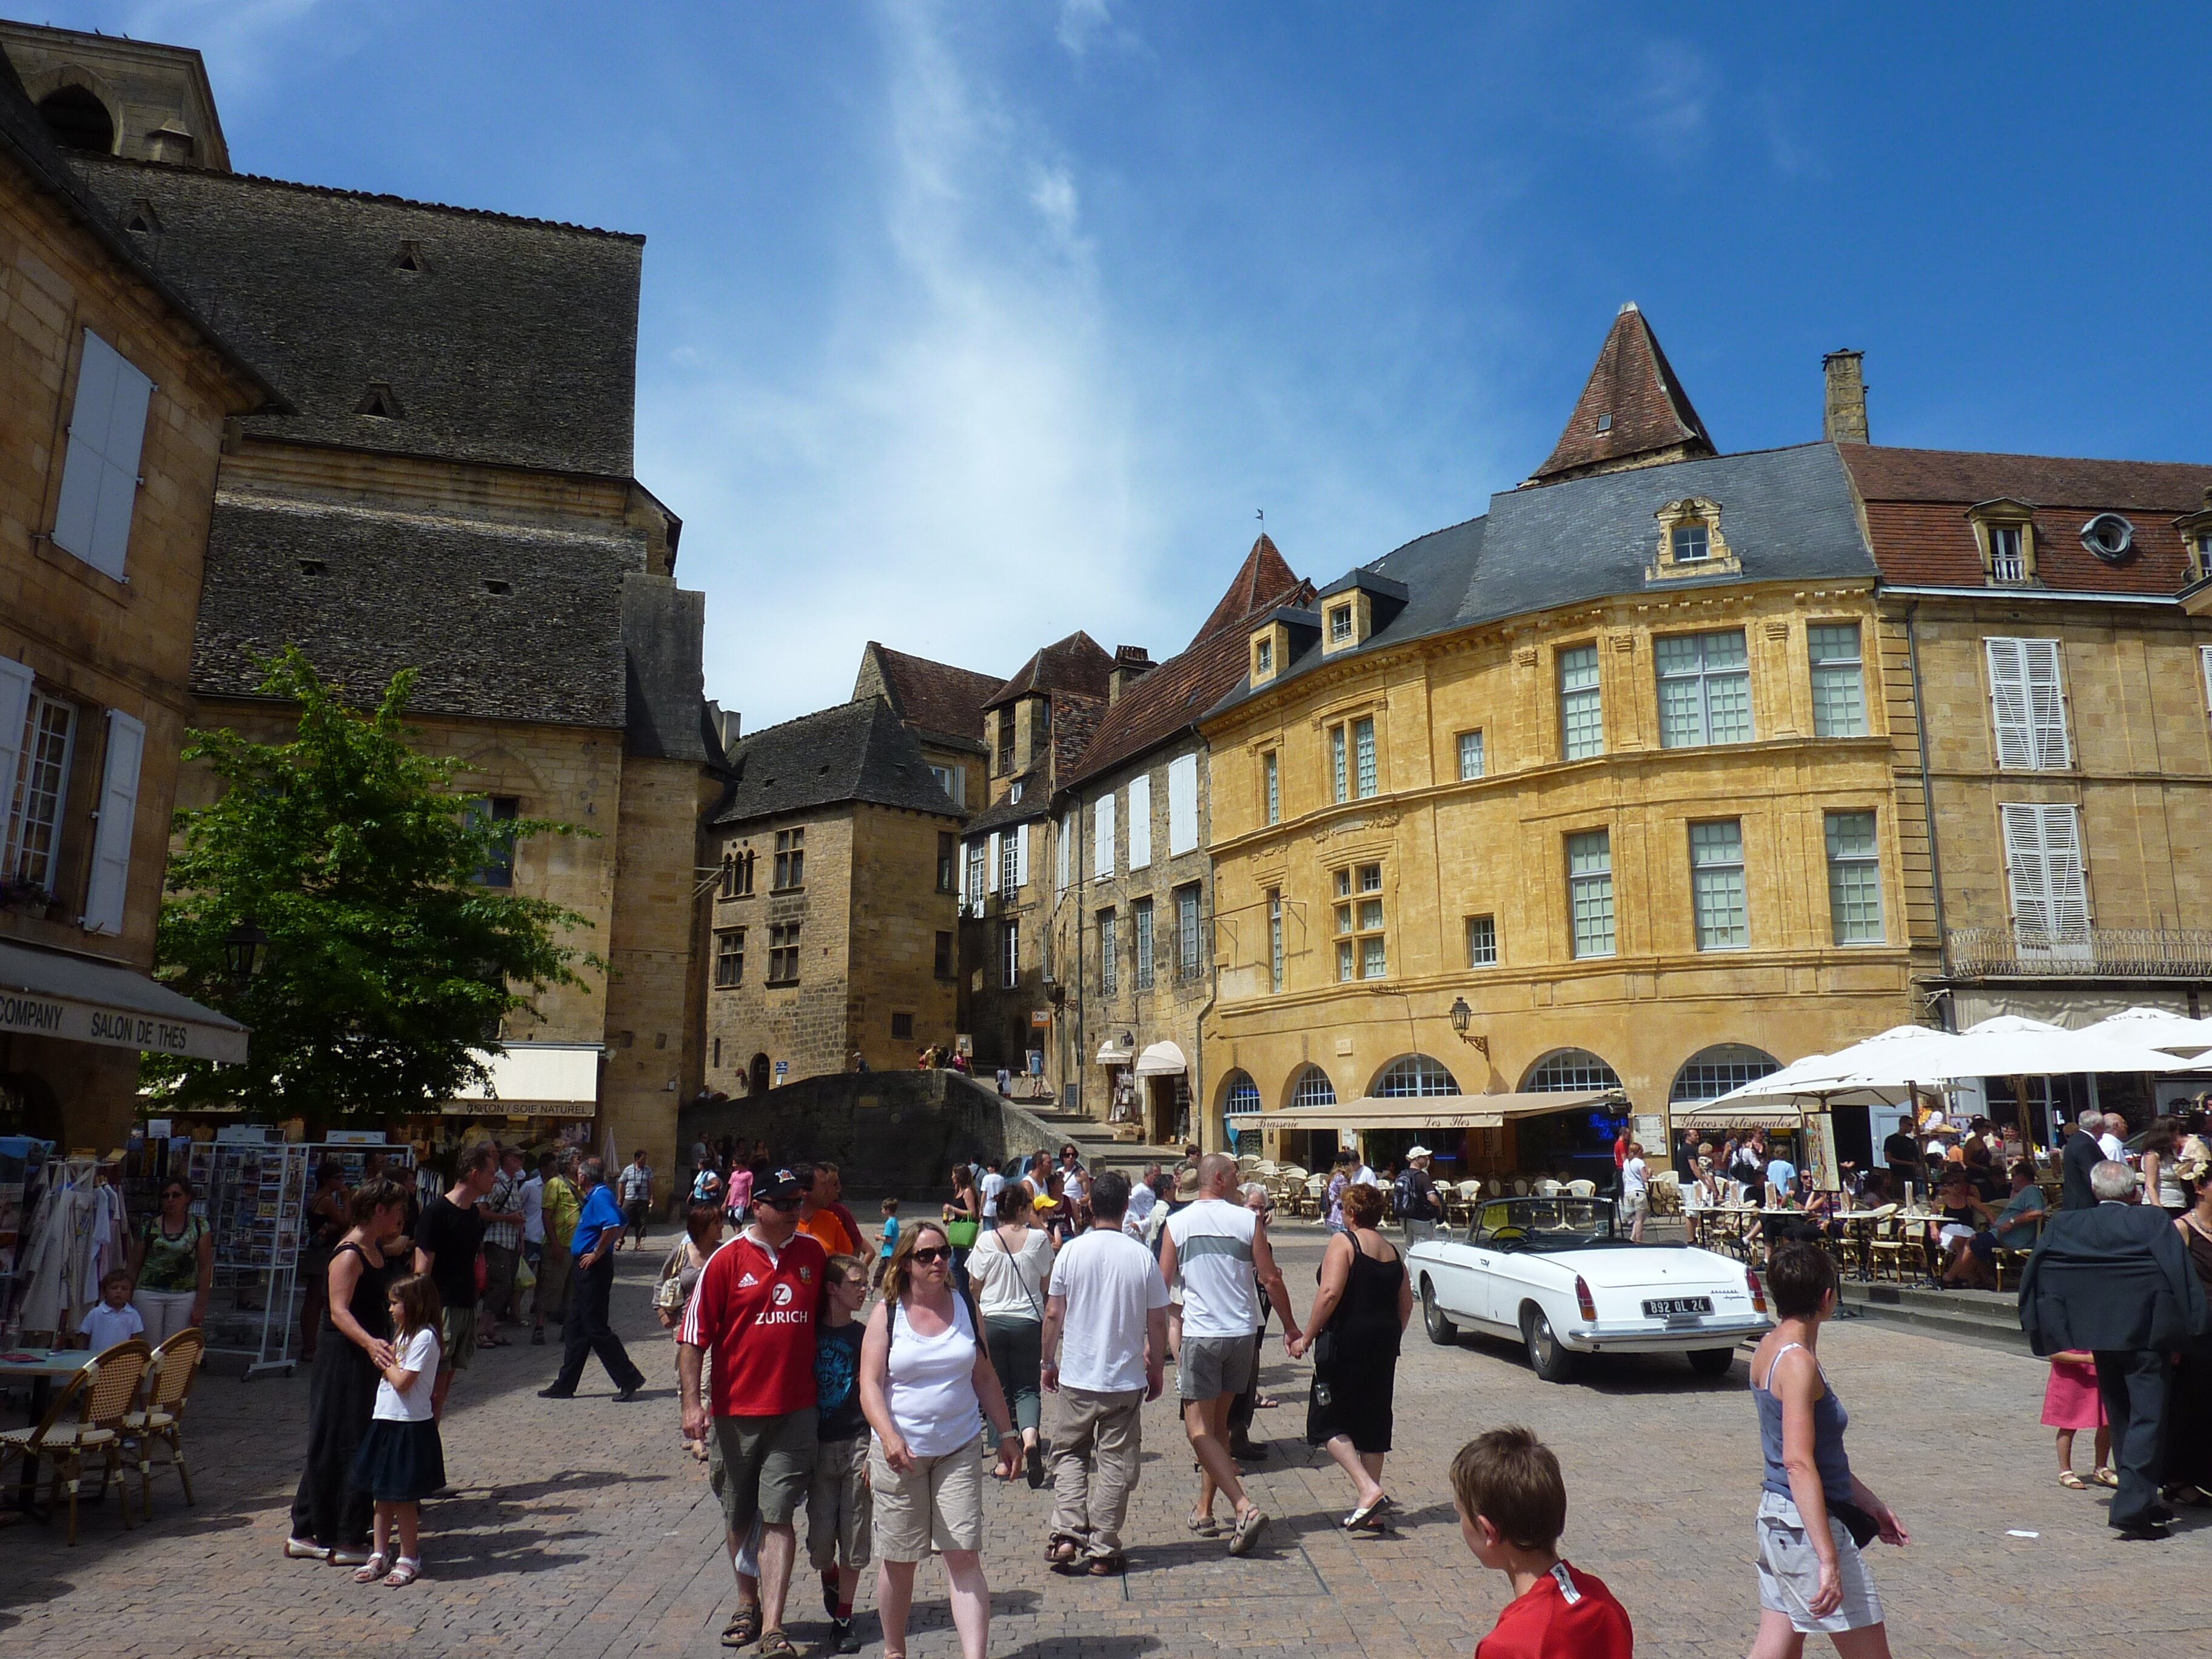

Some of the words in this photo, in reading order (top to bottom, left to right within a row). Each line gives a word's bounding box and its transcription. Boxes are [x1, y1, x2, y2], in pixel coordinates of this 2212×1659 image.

[92, 1013, 133, 1041] SALON
[136, 1021, 152, 1044] DE
[159, 1024, 187, 1049] THES
[513, 1104, 537, 1113] SOIE
[540, 1105, 587, 1114] NATUREL
[1256, 1118, 1299, 1128] Brasserie
[1680, 1116, 1717, 1128] Glaces
[1720, 1116, 1792, 1128] Artisanales
[1651, 1301, 1671, 1314] 892
[1692, 1299, 1704, 1312] 24
[755, 1311, 808, 1325] ZURICH
